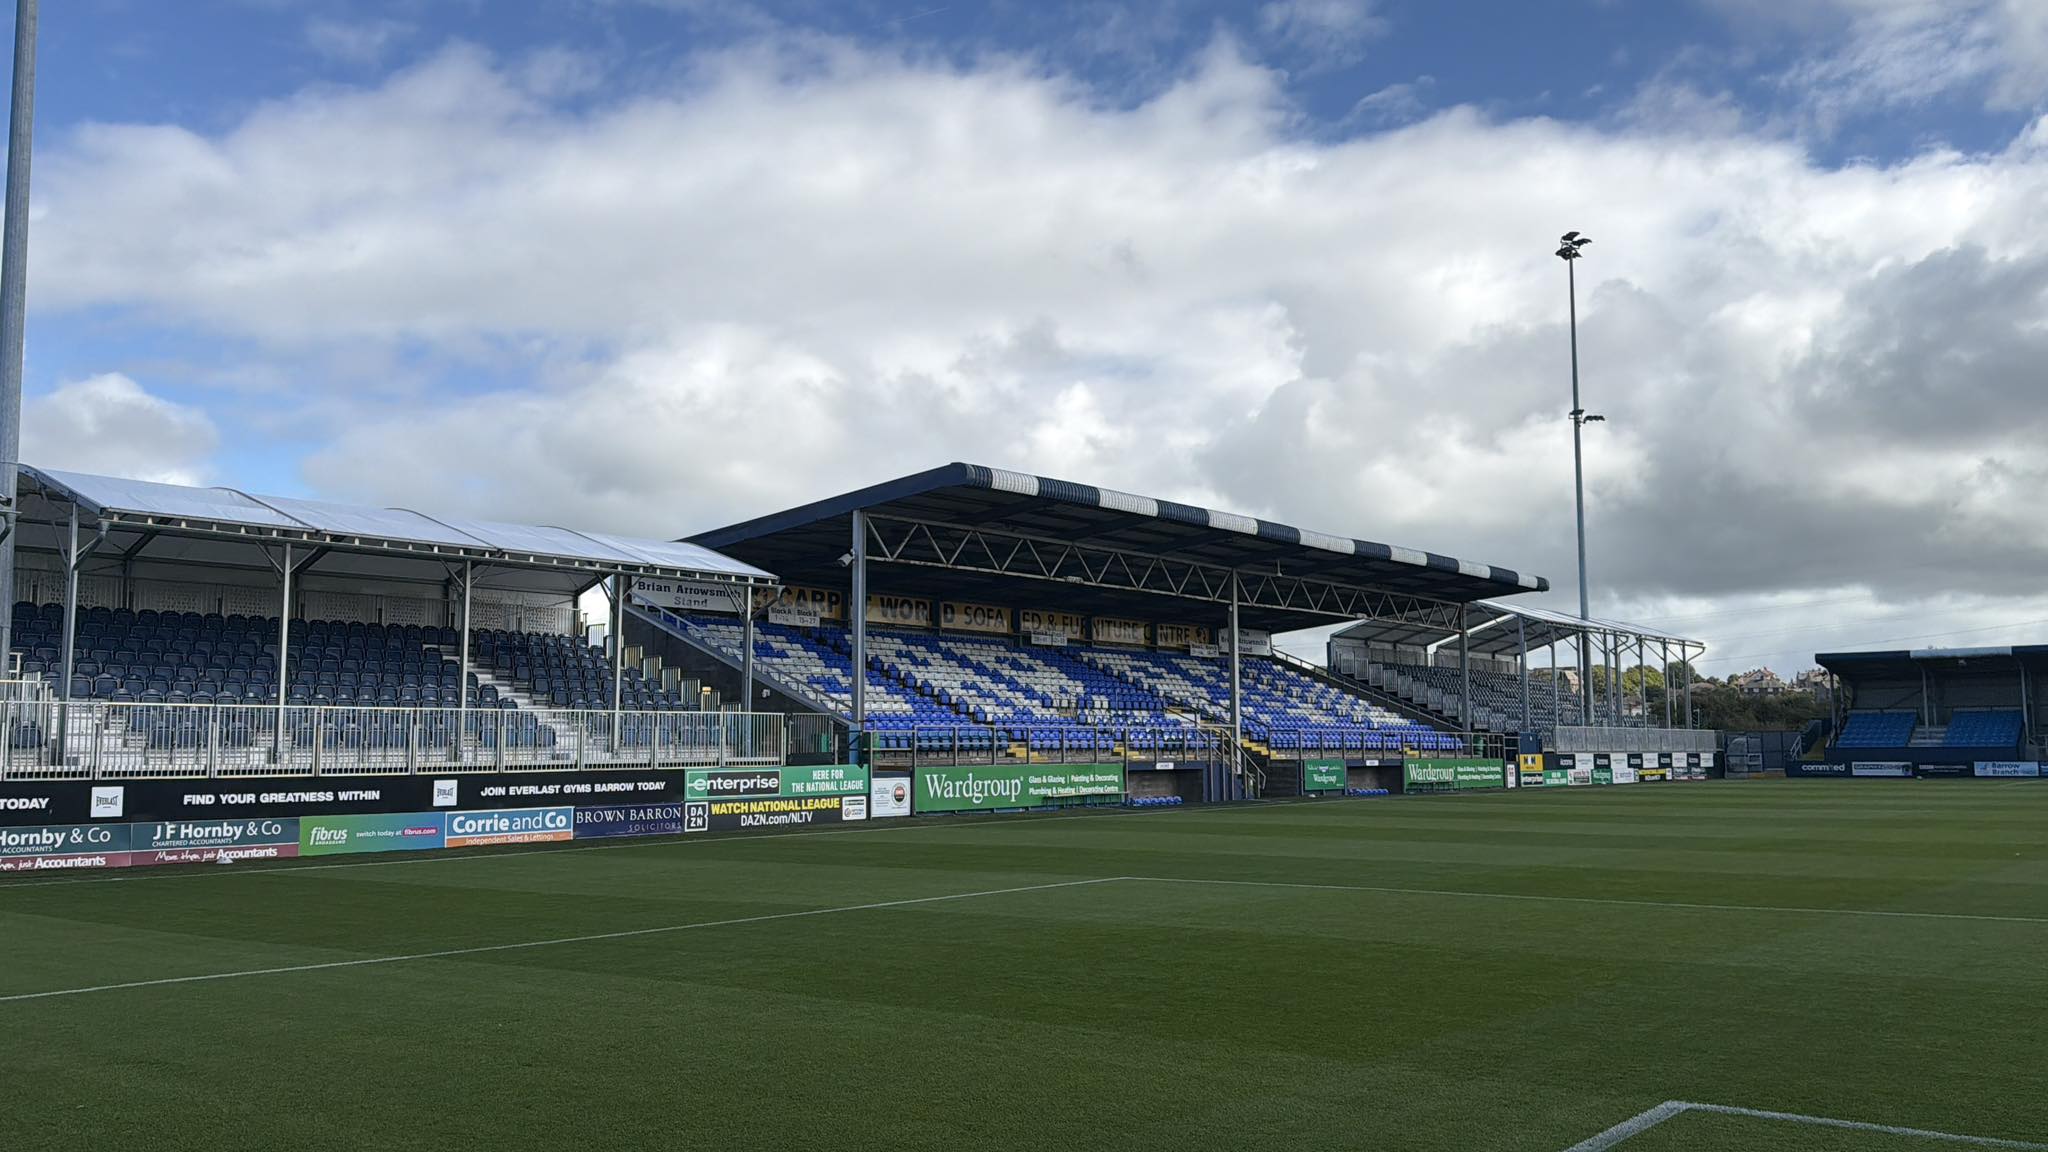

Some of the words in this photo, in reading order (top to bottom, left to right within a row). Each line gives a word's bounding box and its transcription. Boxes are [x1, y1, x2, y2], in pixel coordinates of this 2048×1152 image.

[638, 581, 671, 593] Brian
[674, 596, 708, 607] Stand
[771, 607, 786, 615] Block
[797, 609, 812, 617] Block
[812, 769, 830, 780] HERE
[831, 769, 844, 779] FOR
[1408, 764, 1455, 782] Wardgroup
[480, 786, 506, 797] JOIN
[508, 784, 561, 796] EVERLAST
[563, 783, 592, 793] GYMS
[594, 782, 635, 792] BARROW
[637, 781, 666, 791] TODAY
[693, 774, 779, 793] enterprise
[791, 782, 805, 793] THE
[806, 781, 838, 792] NATIONAL
[839, 780, 864, 791] LEAGUE
[925, 773, 1021, 803] Wardgroup
[0, 798, 50, 810] TODAY
[183, 794, 216, 805] FIND
[219, 793, 256, 805] YOUR
[259, 791, 334, 804] GREATNESS
[338, 790, 380, 801] WITHIN
[690, 807, 704, 817] DA
[711, 802, 749, 815] WATCH
[750, 800, 801, 812] NATIONAL
[801, 797, 840, 810] LEAGUE
[576, 810, 625, 823] BROWN
[629, 807, 682, 820] BARRON
[740, 811, 813, 827] DAZN.com/NLTV
[452, 813, 510, 834] Corrie
[512, 811, 542, 830] and
[544, 811, 567, 828] Co
[628, 821, 682, 832] SOLICITORS
[690, 817, 703, 827] ZN
[70, 828, 83, 843] &
[87, 827, 112, 843] Co
[153, 825, 162, 840] J
[165, 824, 176, 840] F
[180, 822, 243, 840] Hornby
[247, 821, 258, 836] &
[261, 821, 282, 836] Co
[310, 827, 348, 845] fibrus
[356, 830, 376, 838] switch
[377, 830, 395, 838] today
[404, 828, 437, 836] fibrus.com
[152, 839, 188, 848] CHARTERED
[189, 838, 233, 846] ACCOUNTANTS
[465, 835, 507, 846] Independent
[508, 834, 523, 843] Sales
[524, 833, 530, 841] &
[2, 845, 53, 854] ACCOUNTANTS
[217, 847, 278, 860] Accountants
[34, 856, 107, 869] Accountants
